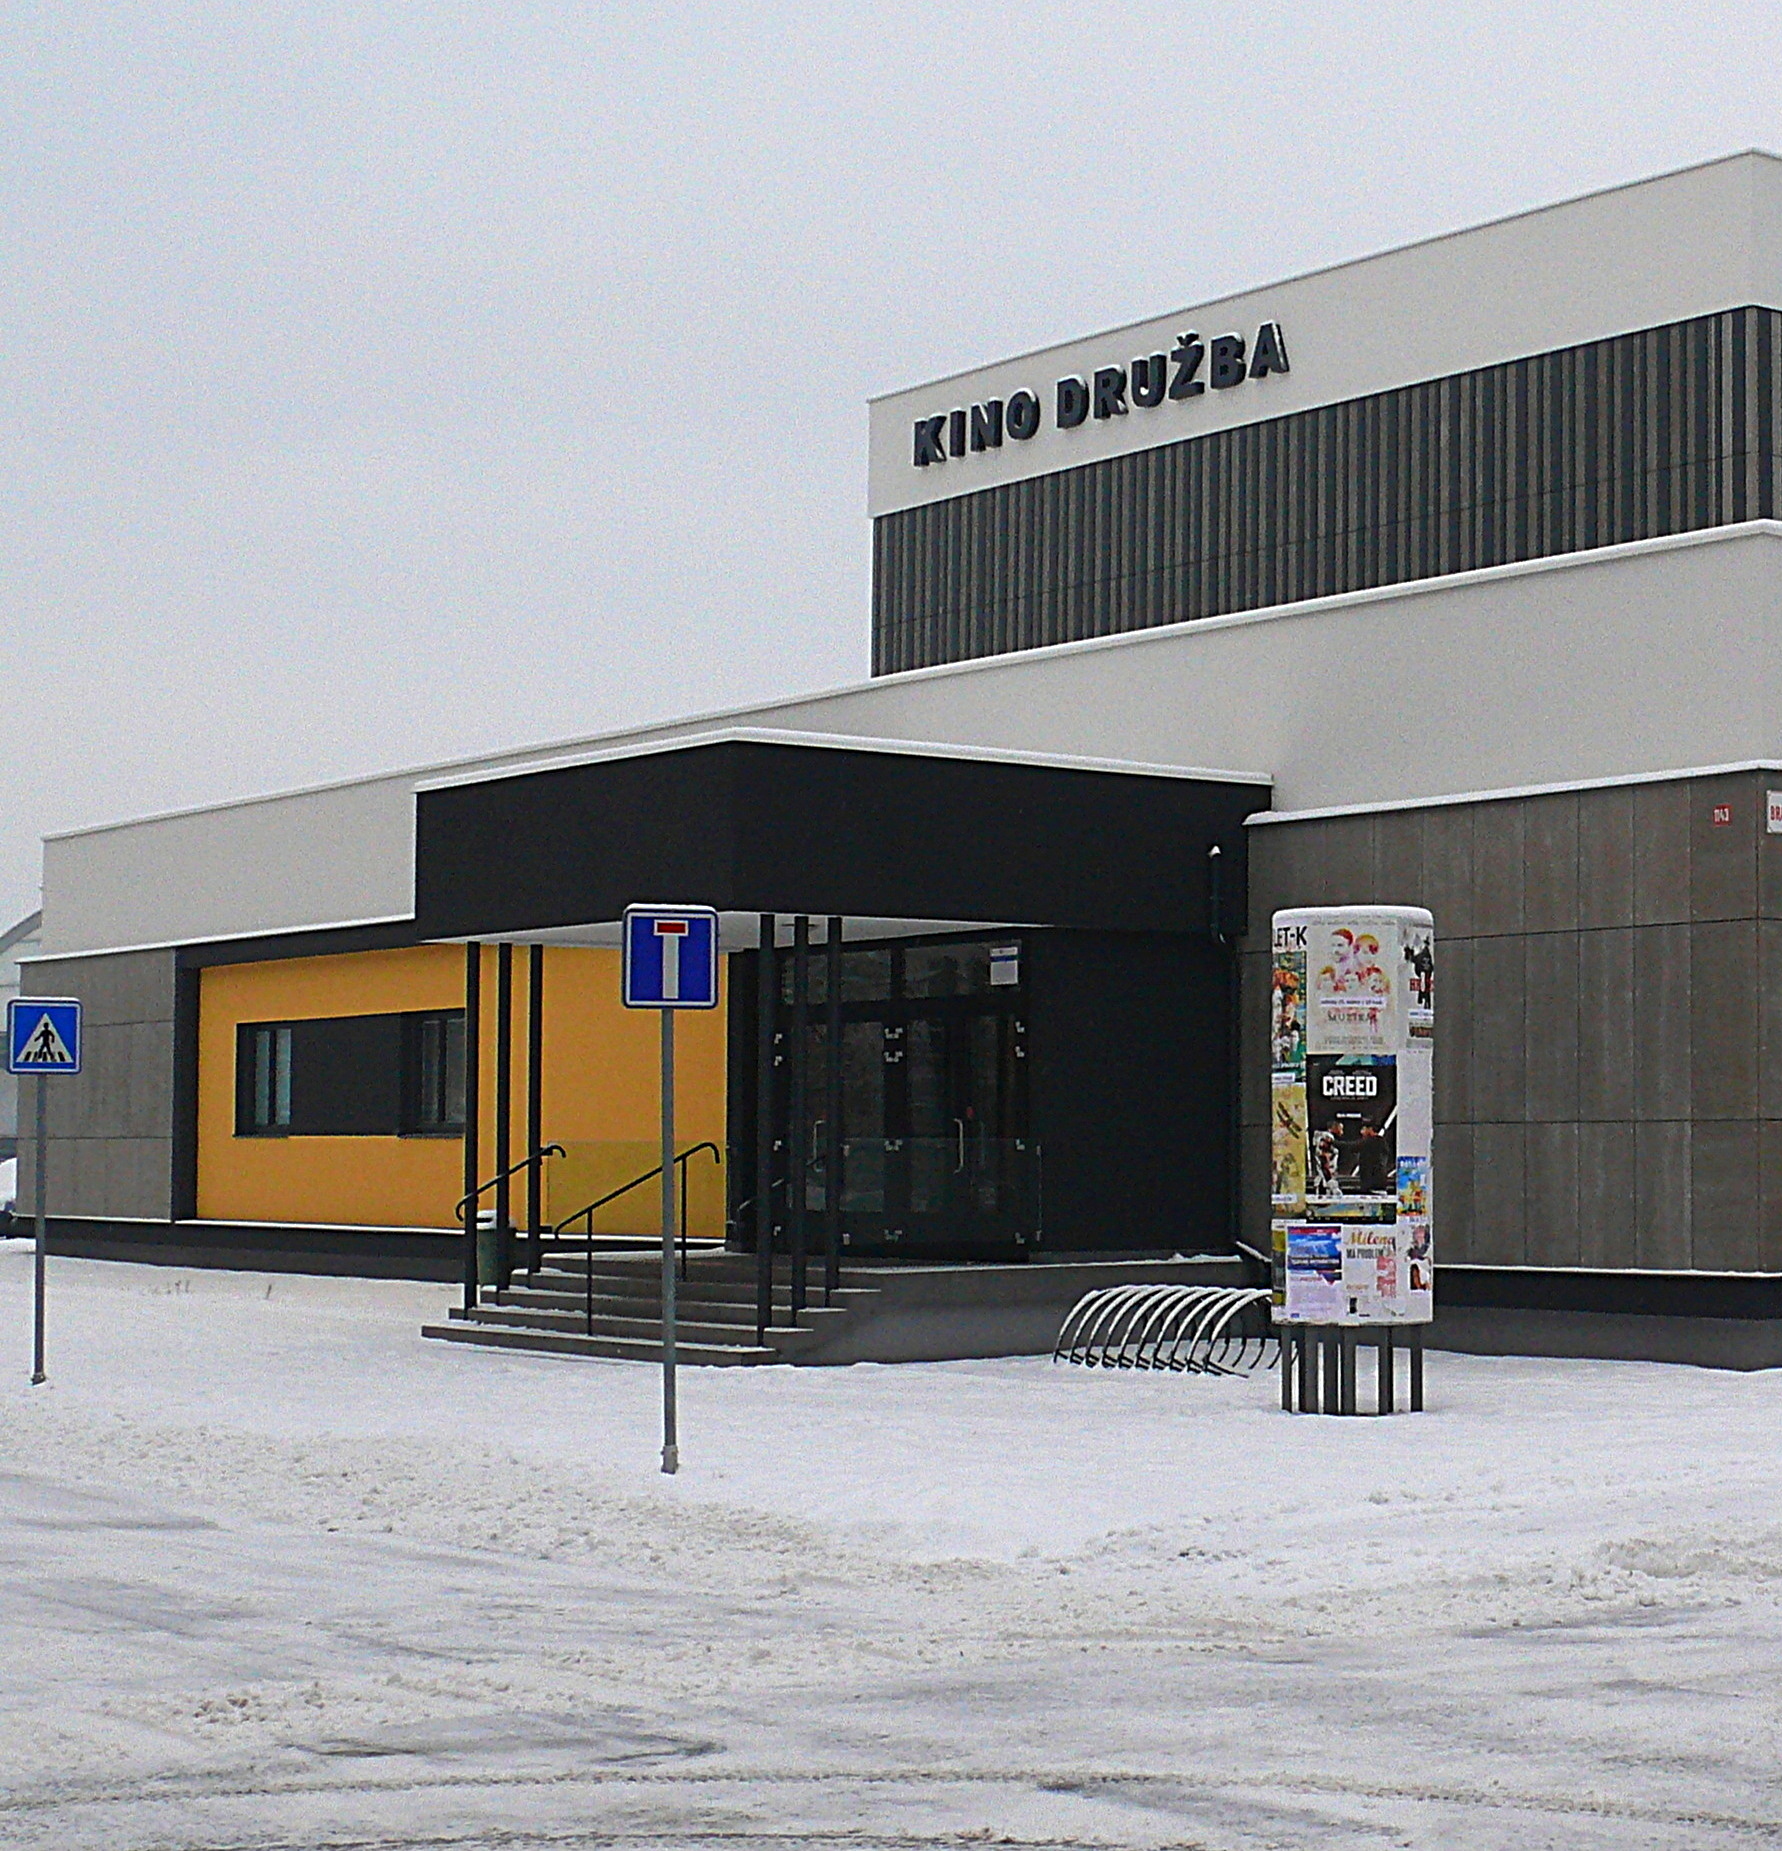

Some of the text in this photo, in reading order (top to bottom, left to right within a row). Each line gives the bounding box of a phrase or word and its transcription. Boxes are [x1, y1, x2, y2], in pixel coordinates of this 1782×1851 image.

[913, 320, 1290, 468] KINO DRUŽBA
[1323, 1076, 1377, 1096] CREED
